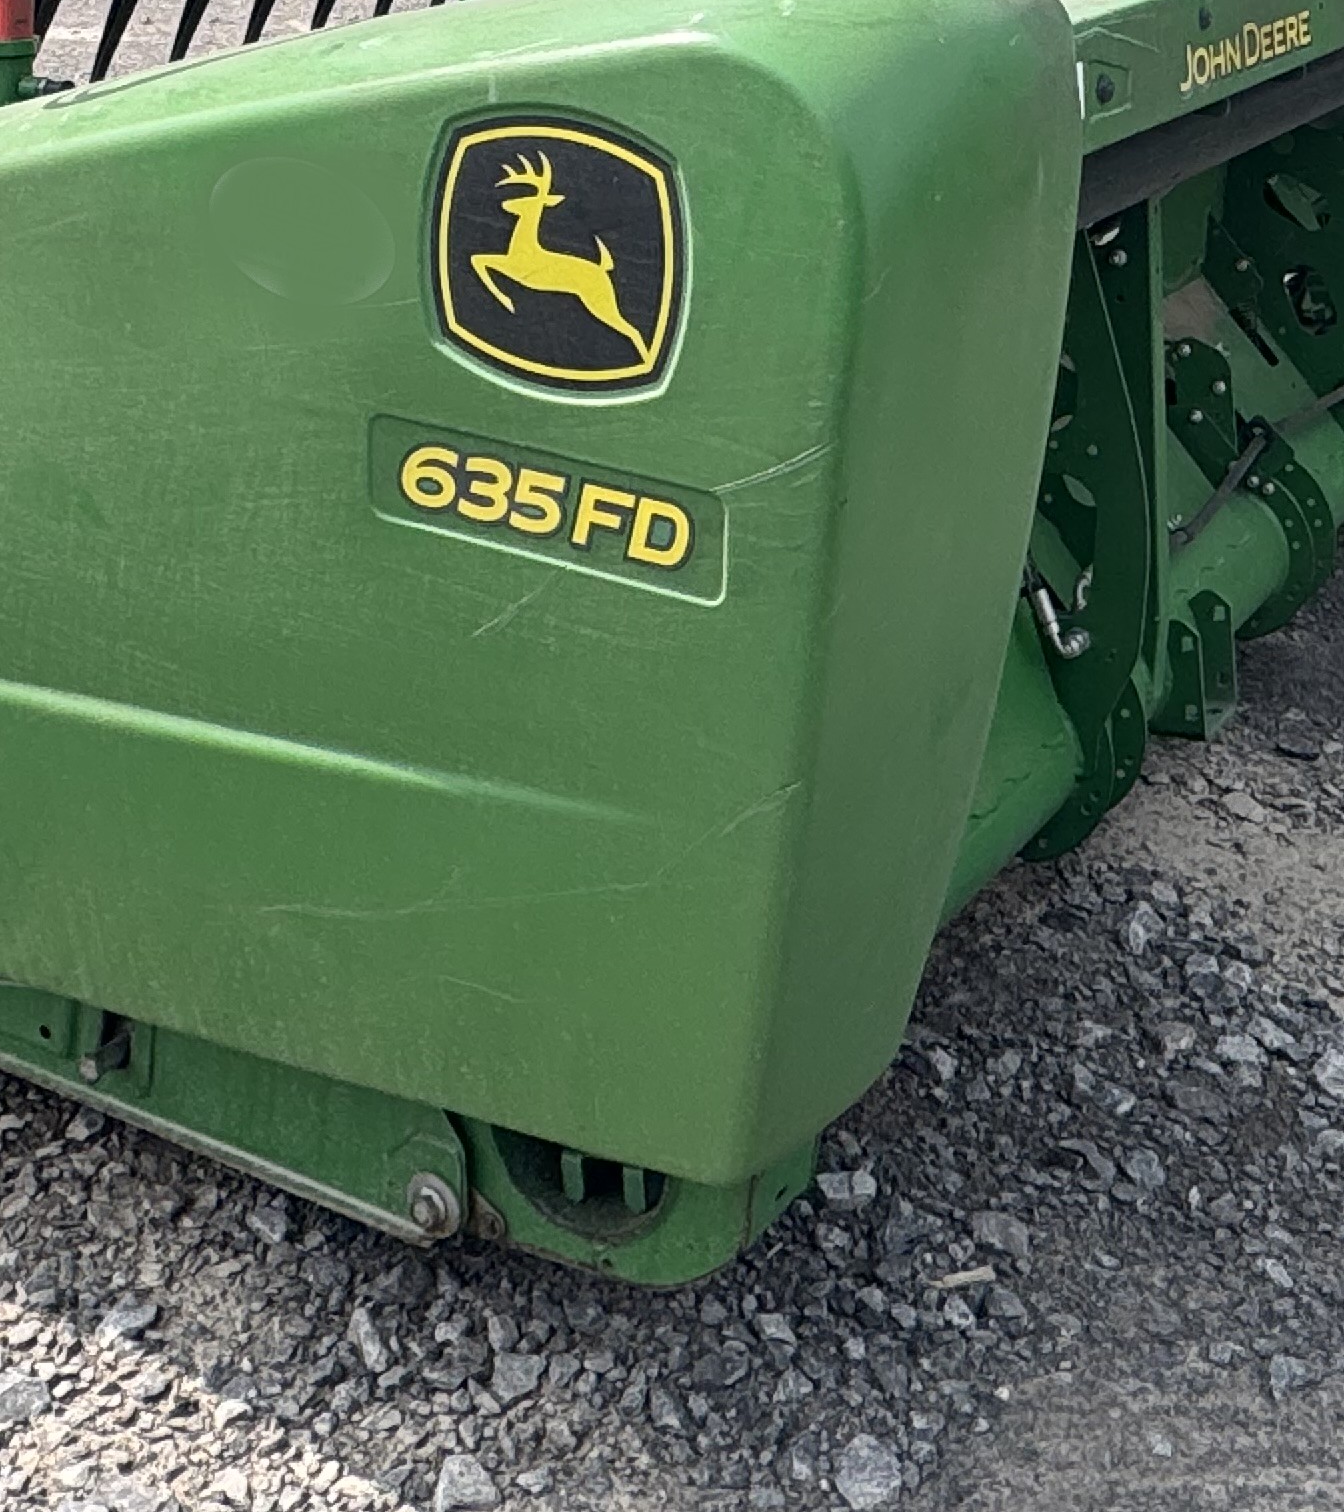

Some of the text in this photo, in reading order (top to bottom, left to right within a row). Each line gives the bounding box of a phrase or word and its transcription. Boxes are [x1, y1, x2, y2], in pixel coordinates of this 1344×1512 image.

[1180, 10, 1312, 92] JOHN DEERE
[399, 445, 693, 569] 635FD
